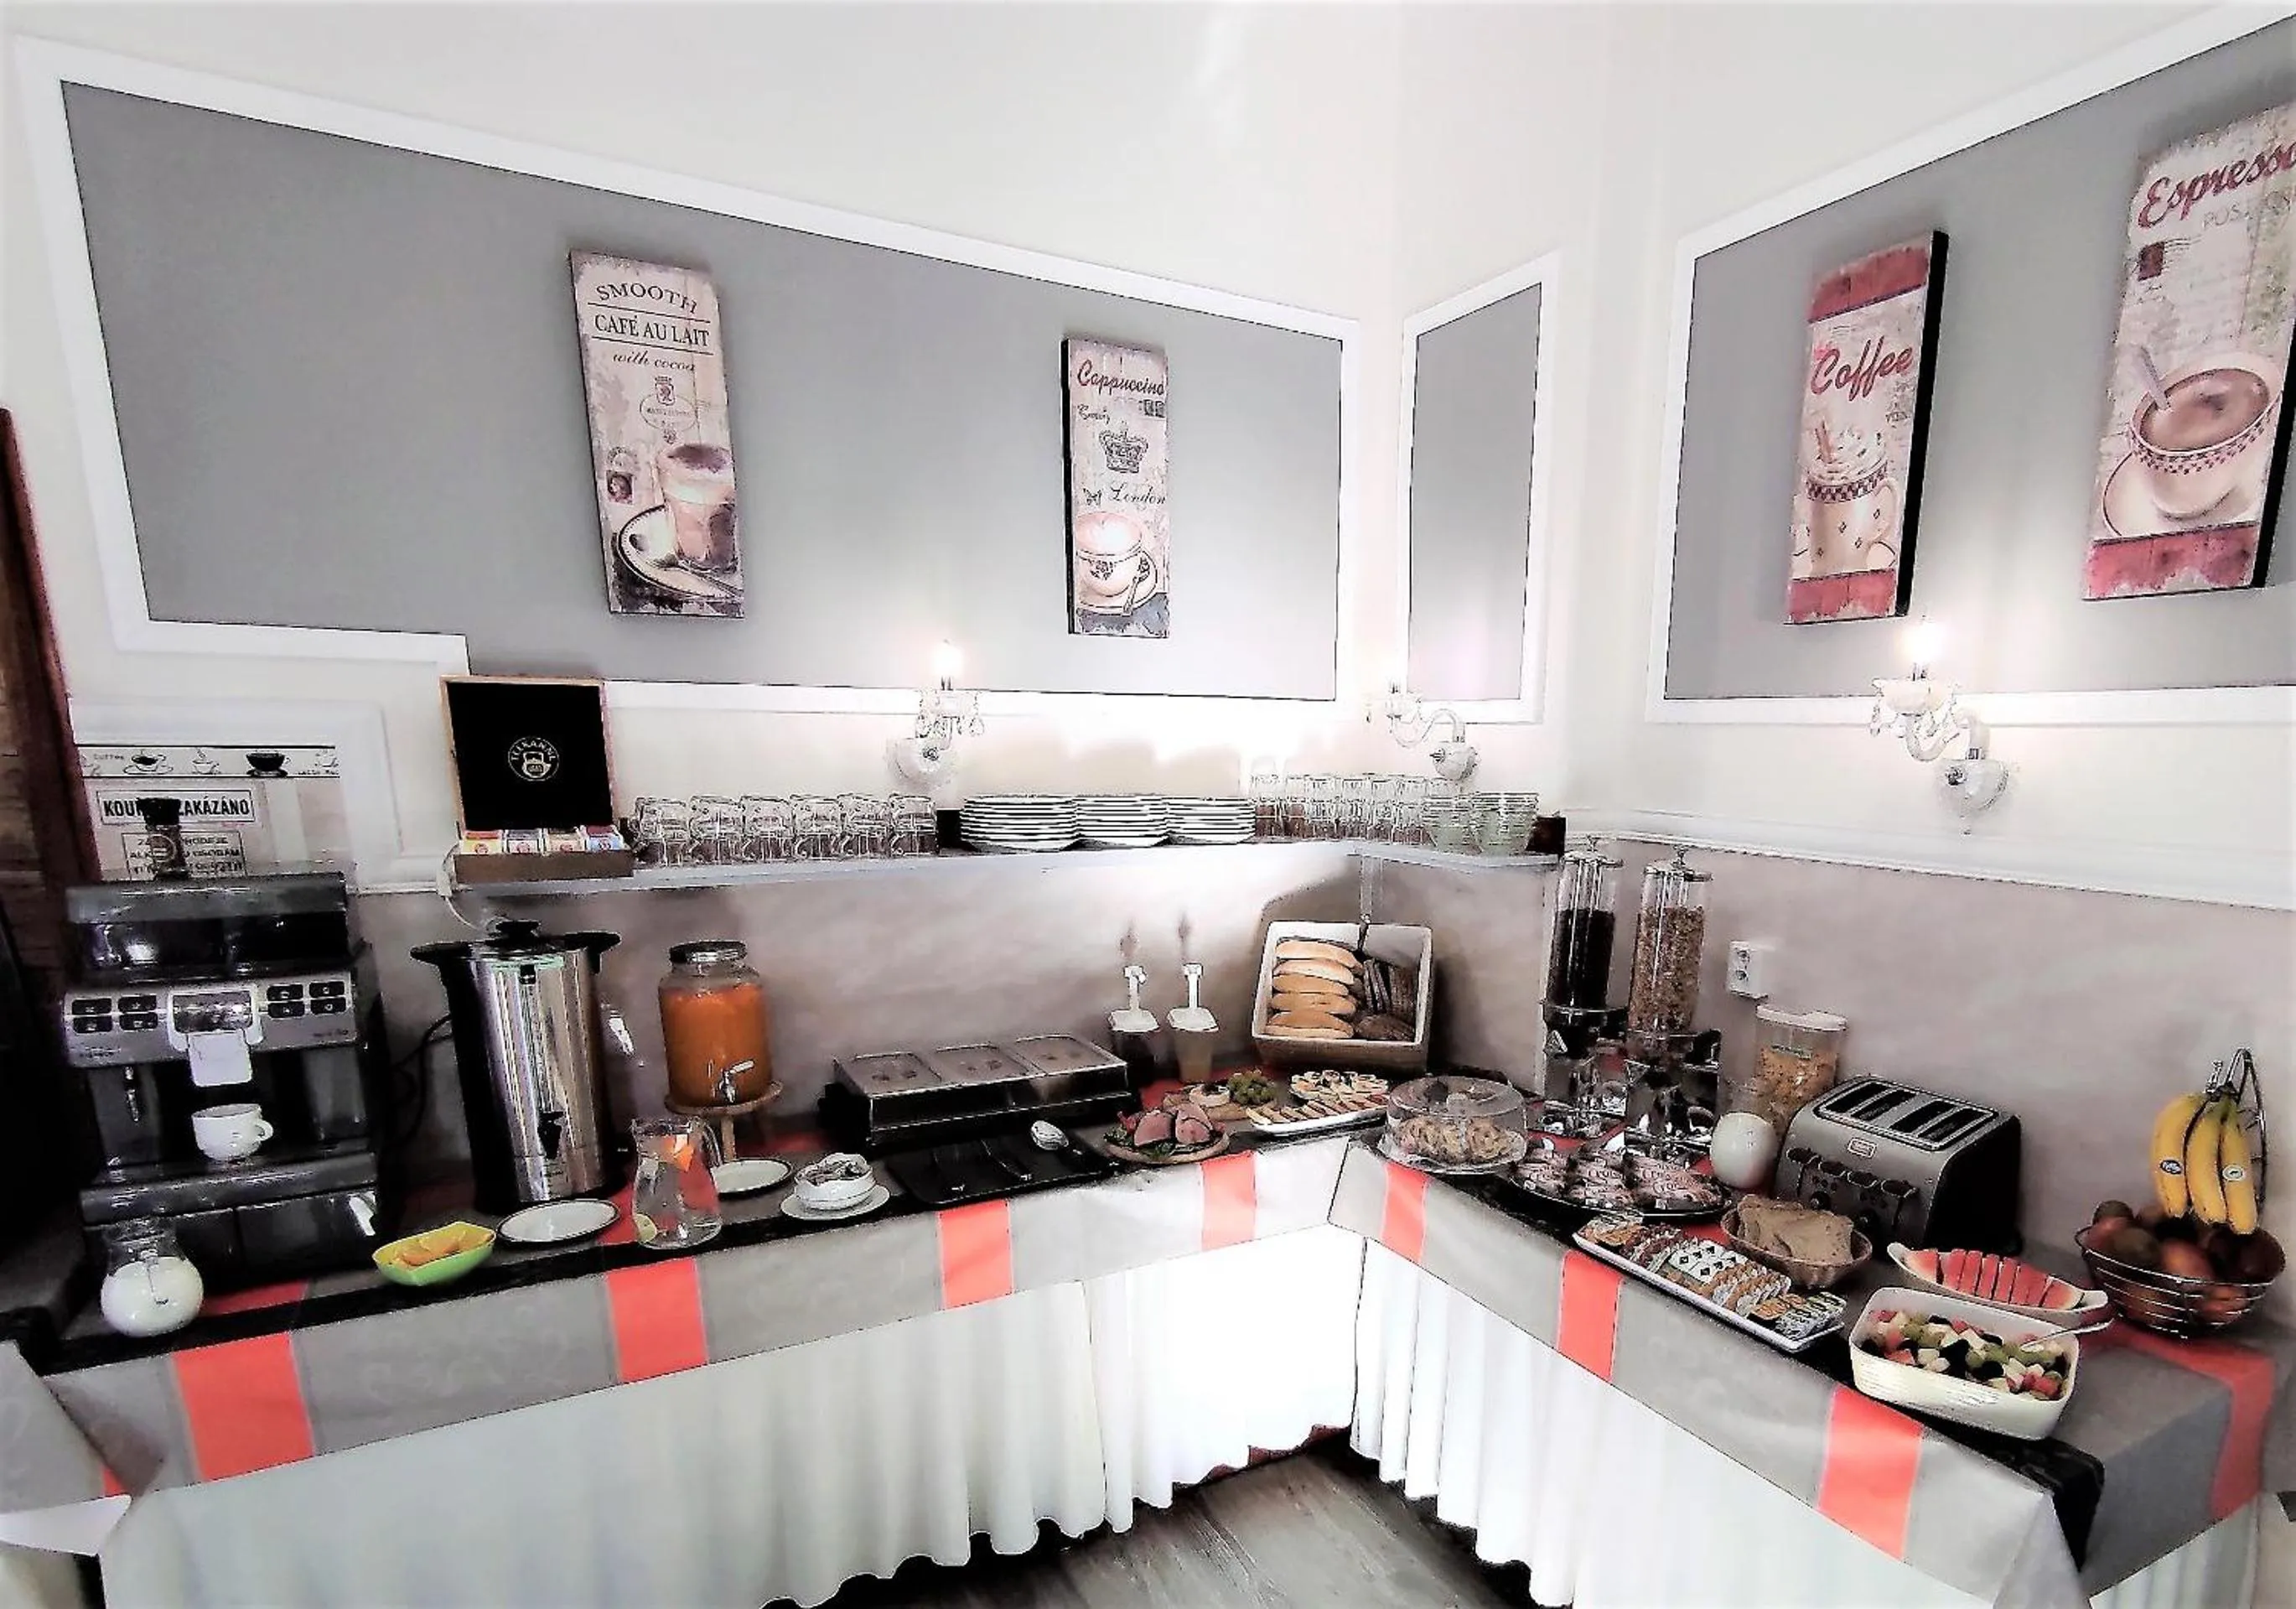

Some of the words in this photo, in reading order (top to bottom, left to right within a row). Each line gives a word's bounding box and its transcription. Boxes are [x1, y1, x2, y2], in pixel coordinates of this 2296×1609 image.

[596, 283, 697, 314] SMOOTH
[594, 314, 639, 336] CAFÉ
[644, 322, 667, 340] AU
[671, 324, 709, 346] LAIT
[613, 350, 650, 366] with
[654, 358, 695, 372] cocoa
[1810, 335, 1914, 402] Coffee
[1077, 360, 1165, 396] Cappuccino
[1110, 482, 1166, 505] London
[179, 797, 251, 817] ZAKÁZÁNO
